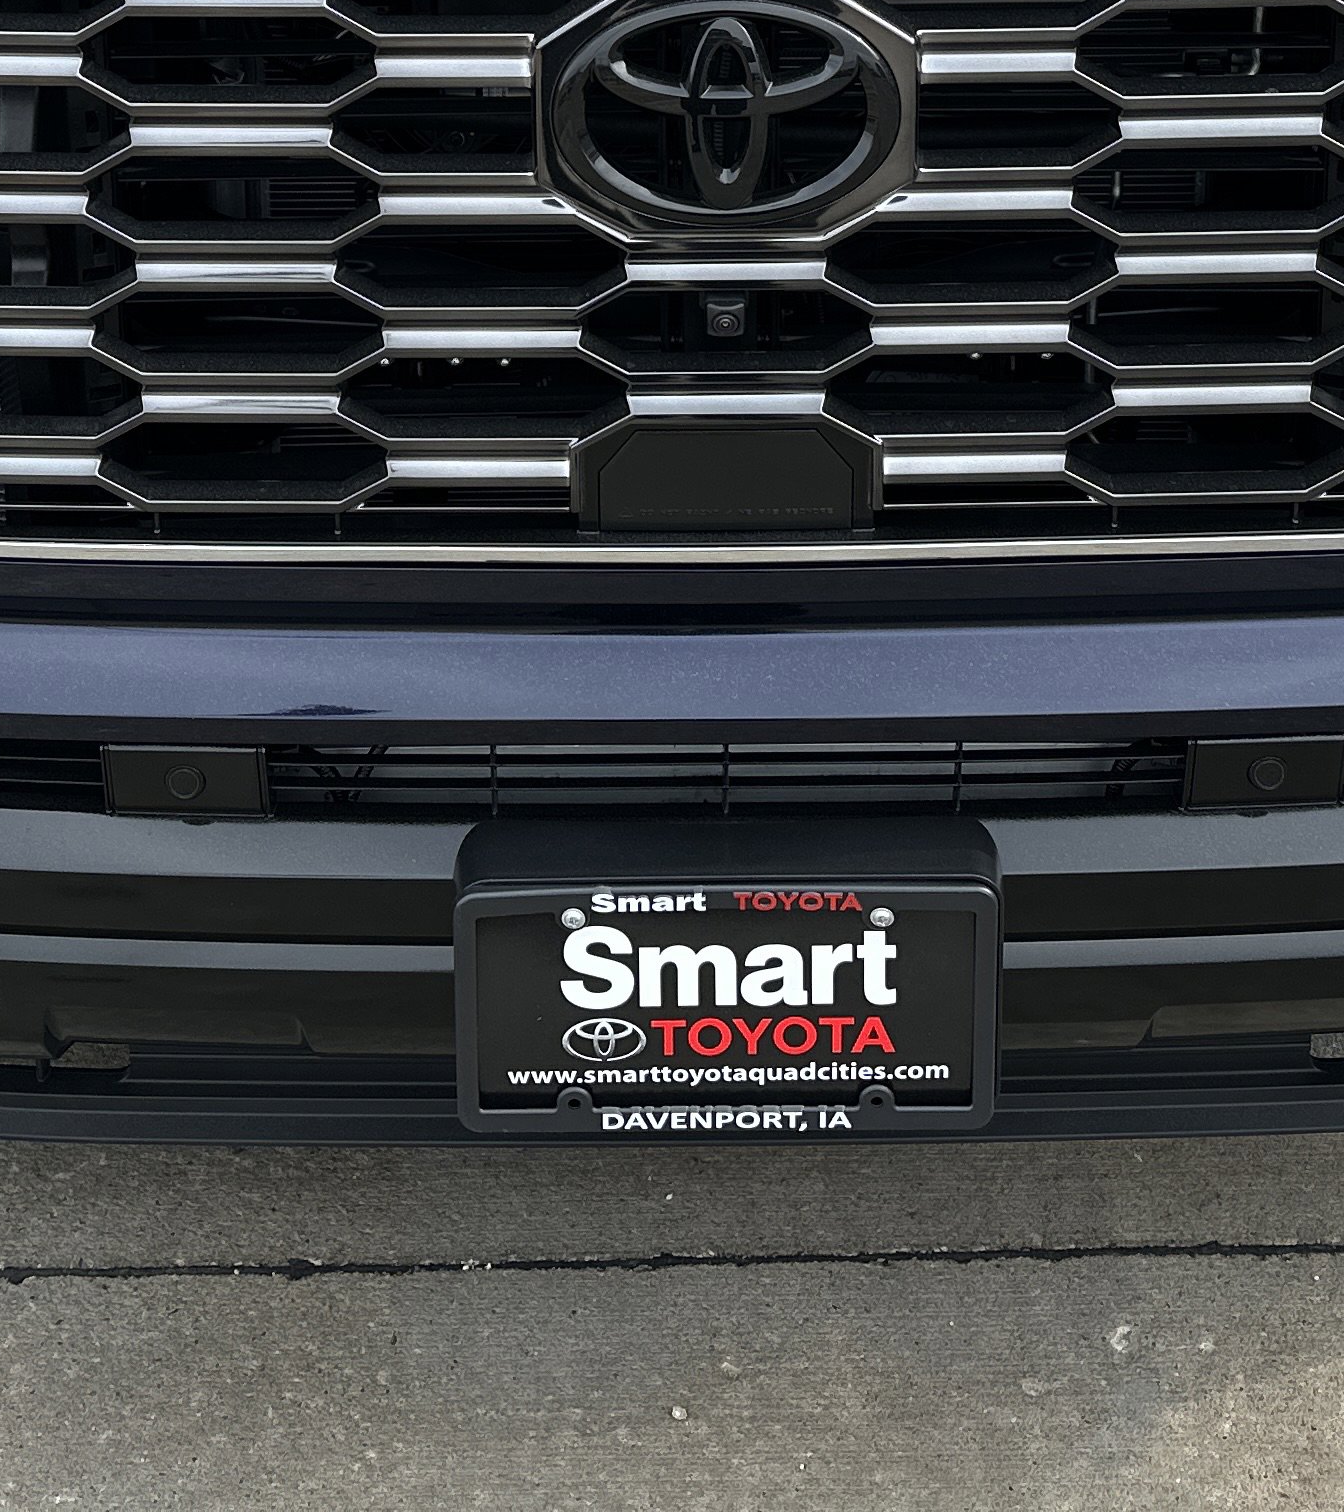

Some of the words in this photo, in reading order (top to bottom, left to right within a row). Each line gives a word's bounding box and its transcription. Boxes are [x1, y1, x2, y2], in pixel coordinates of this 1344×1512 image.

[590, 890, 707, 914] Smart
[732, 891, 863, 912] TOYOTA
[560, 925, 897, 1010] Smart
[650, 1016, 896, 1057] TOYOTA
[507, 1061, 950, 1086] www.smarttoyotaquadcities.com
[601, 1110, 808, 1131] DAVENPORT,
[818, 1110, 852, 1130] IA
